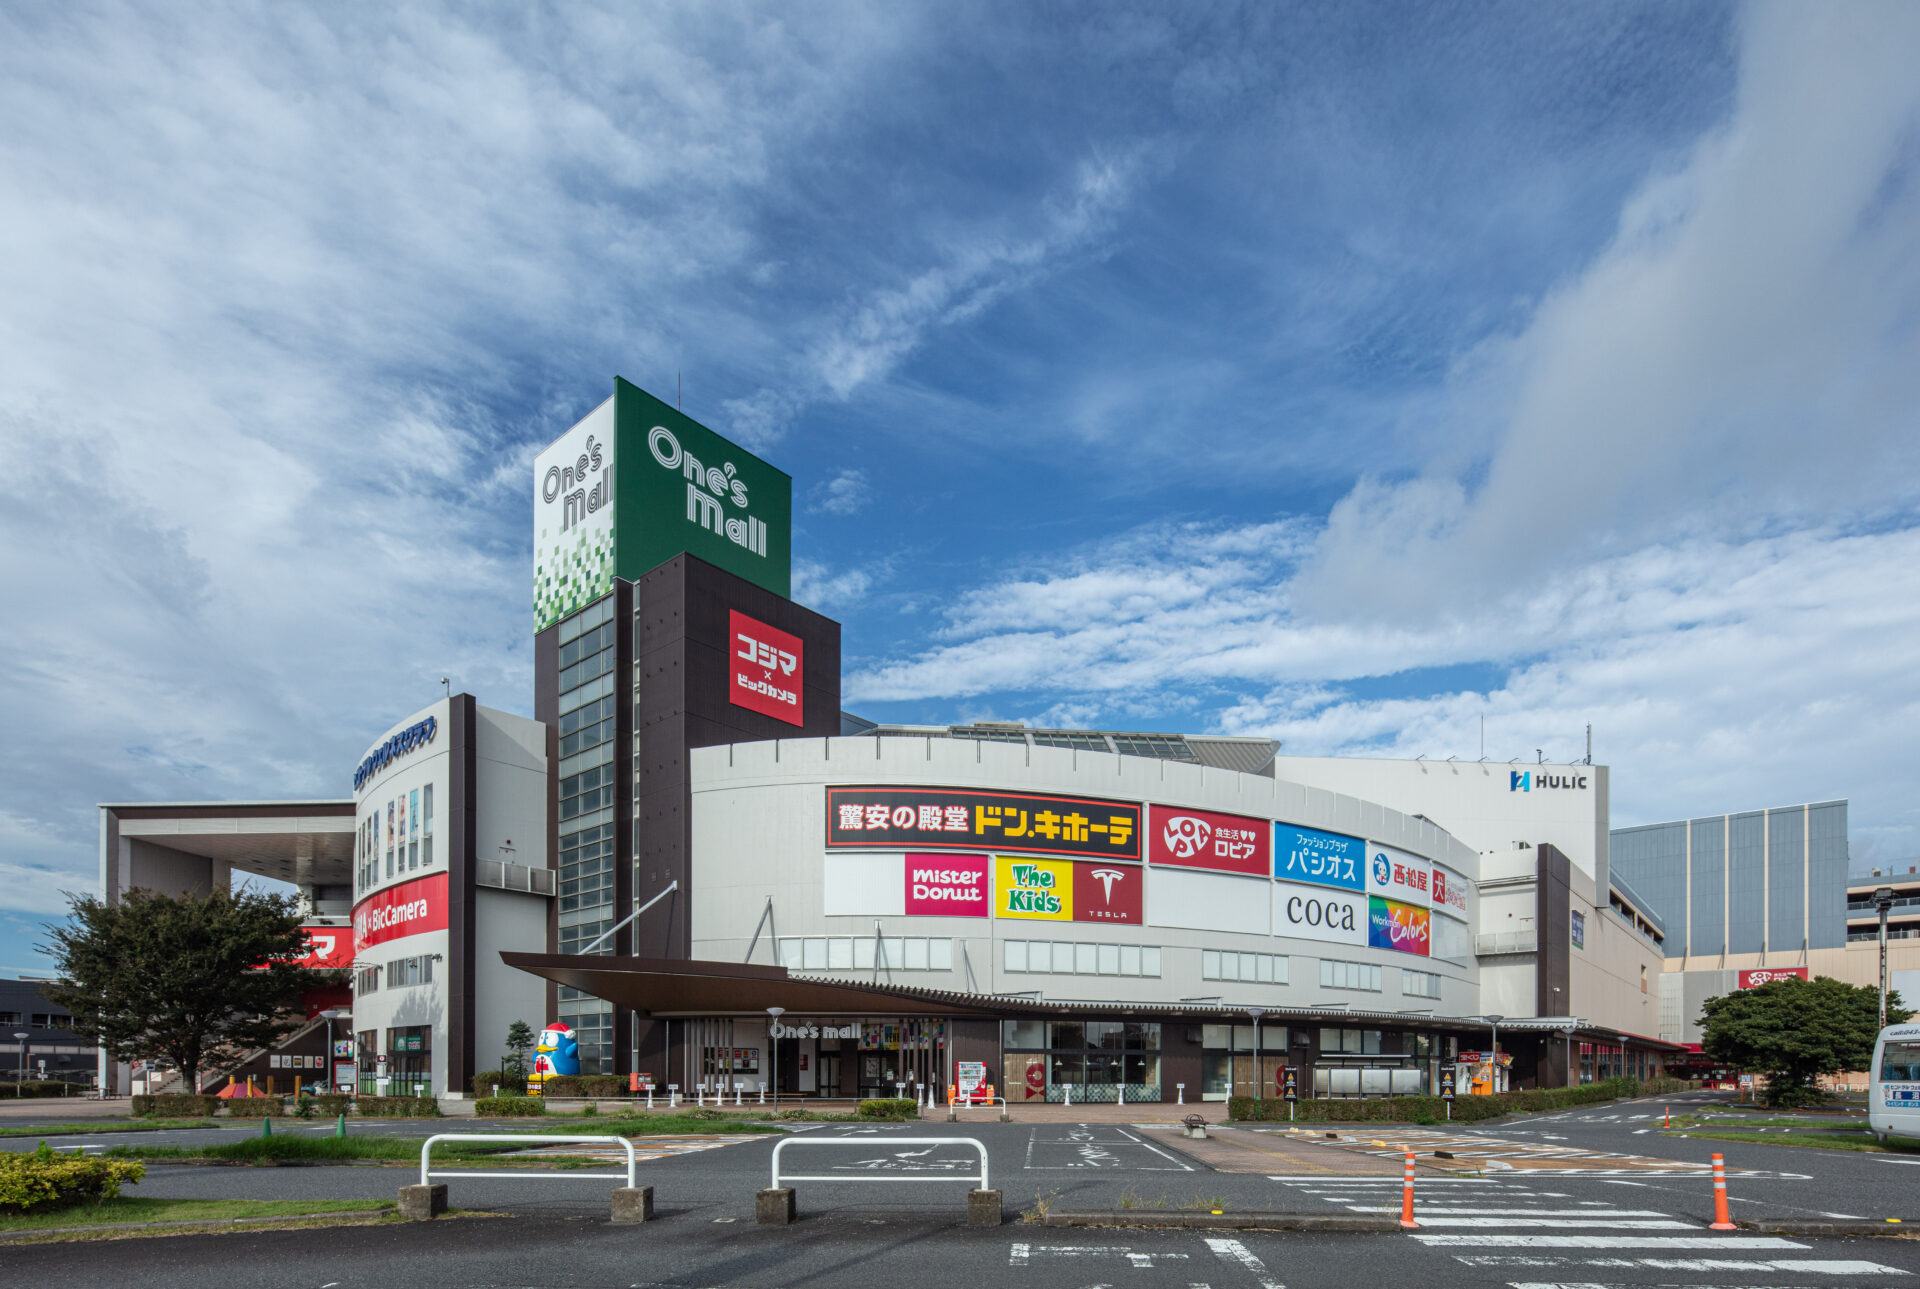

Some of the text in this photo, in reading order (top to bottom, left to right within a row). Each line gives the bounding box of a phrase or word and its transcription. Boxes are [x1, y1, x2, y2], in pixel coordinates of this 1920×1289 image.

[543, 434, 602, 504] One's
[648, 425, 748, 508] One's
[737, 633, 797, 676] コジマ
[737, 672, 797, 706] ビックカメラ
[1536, 775, 1587, 789] HULIC
[838, 803, 969, 832] 驚安の殿堂
[1215, 840, 1256, 859] ロピア
[1296, 833, 1348, 853] ファッションプラザ
[913, 868, 982, 885] Mister
[1011, 863, 1057, 888] The
[1287, 848, 1356, 882] パシオス
[1394, 863, 1427, 892] 西松屋
[913, 884, 982, 902] Donut
[1435, 874, 1444, 901] 犬
[1006, 889, 1062, 914] Kids
[1089, 910, 1127, 919] TESLA
[1287, 896, 1356, 931] coca
[372, 899, 427, 932] BicCamera
[1372, 913, 1401, 929] Workman
[1390, 909, 1428, 942] Colors
[769, 1021, 820, 1039] One's
